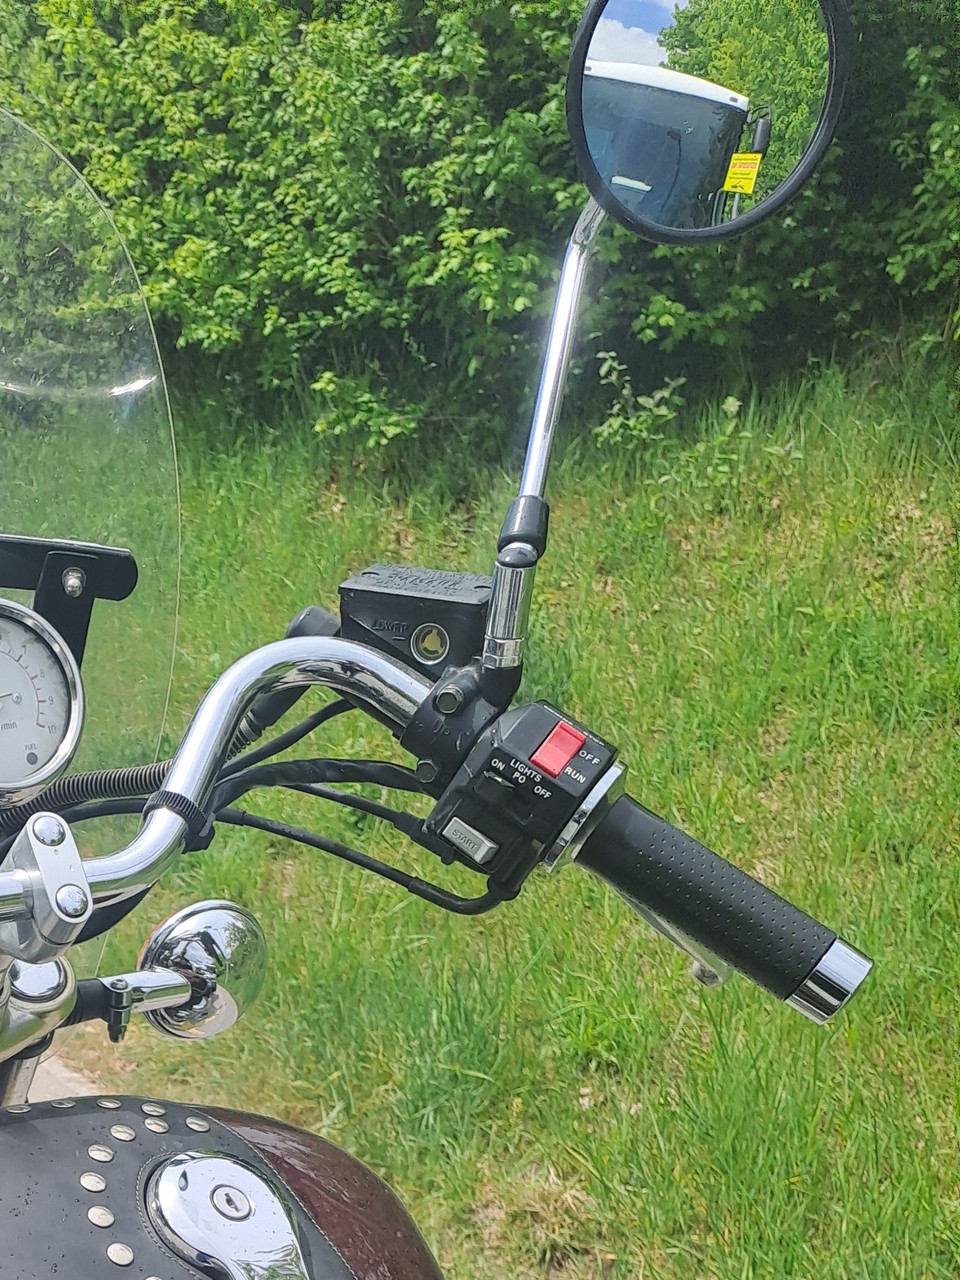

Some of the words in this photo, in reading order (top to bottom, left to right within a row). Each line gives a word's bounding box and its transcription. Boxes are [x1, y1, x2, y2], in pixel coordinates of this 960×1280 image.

[47, 725, 57, 735] 10
[24, 743, 38, 751] FUEL
[578, 749, 601, 766] OFF
[491, 758, 506, 772] ON
[509, 758, 543, 783] LIGHTS
[512, 771, 527, 784] PO
[563, 766, 587, 784] RUN
[533, 785, 553, 799] OFF
[451, 829, 478, 850] START
